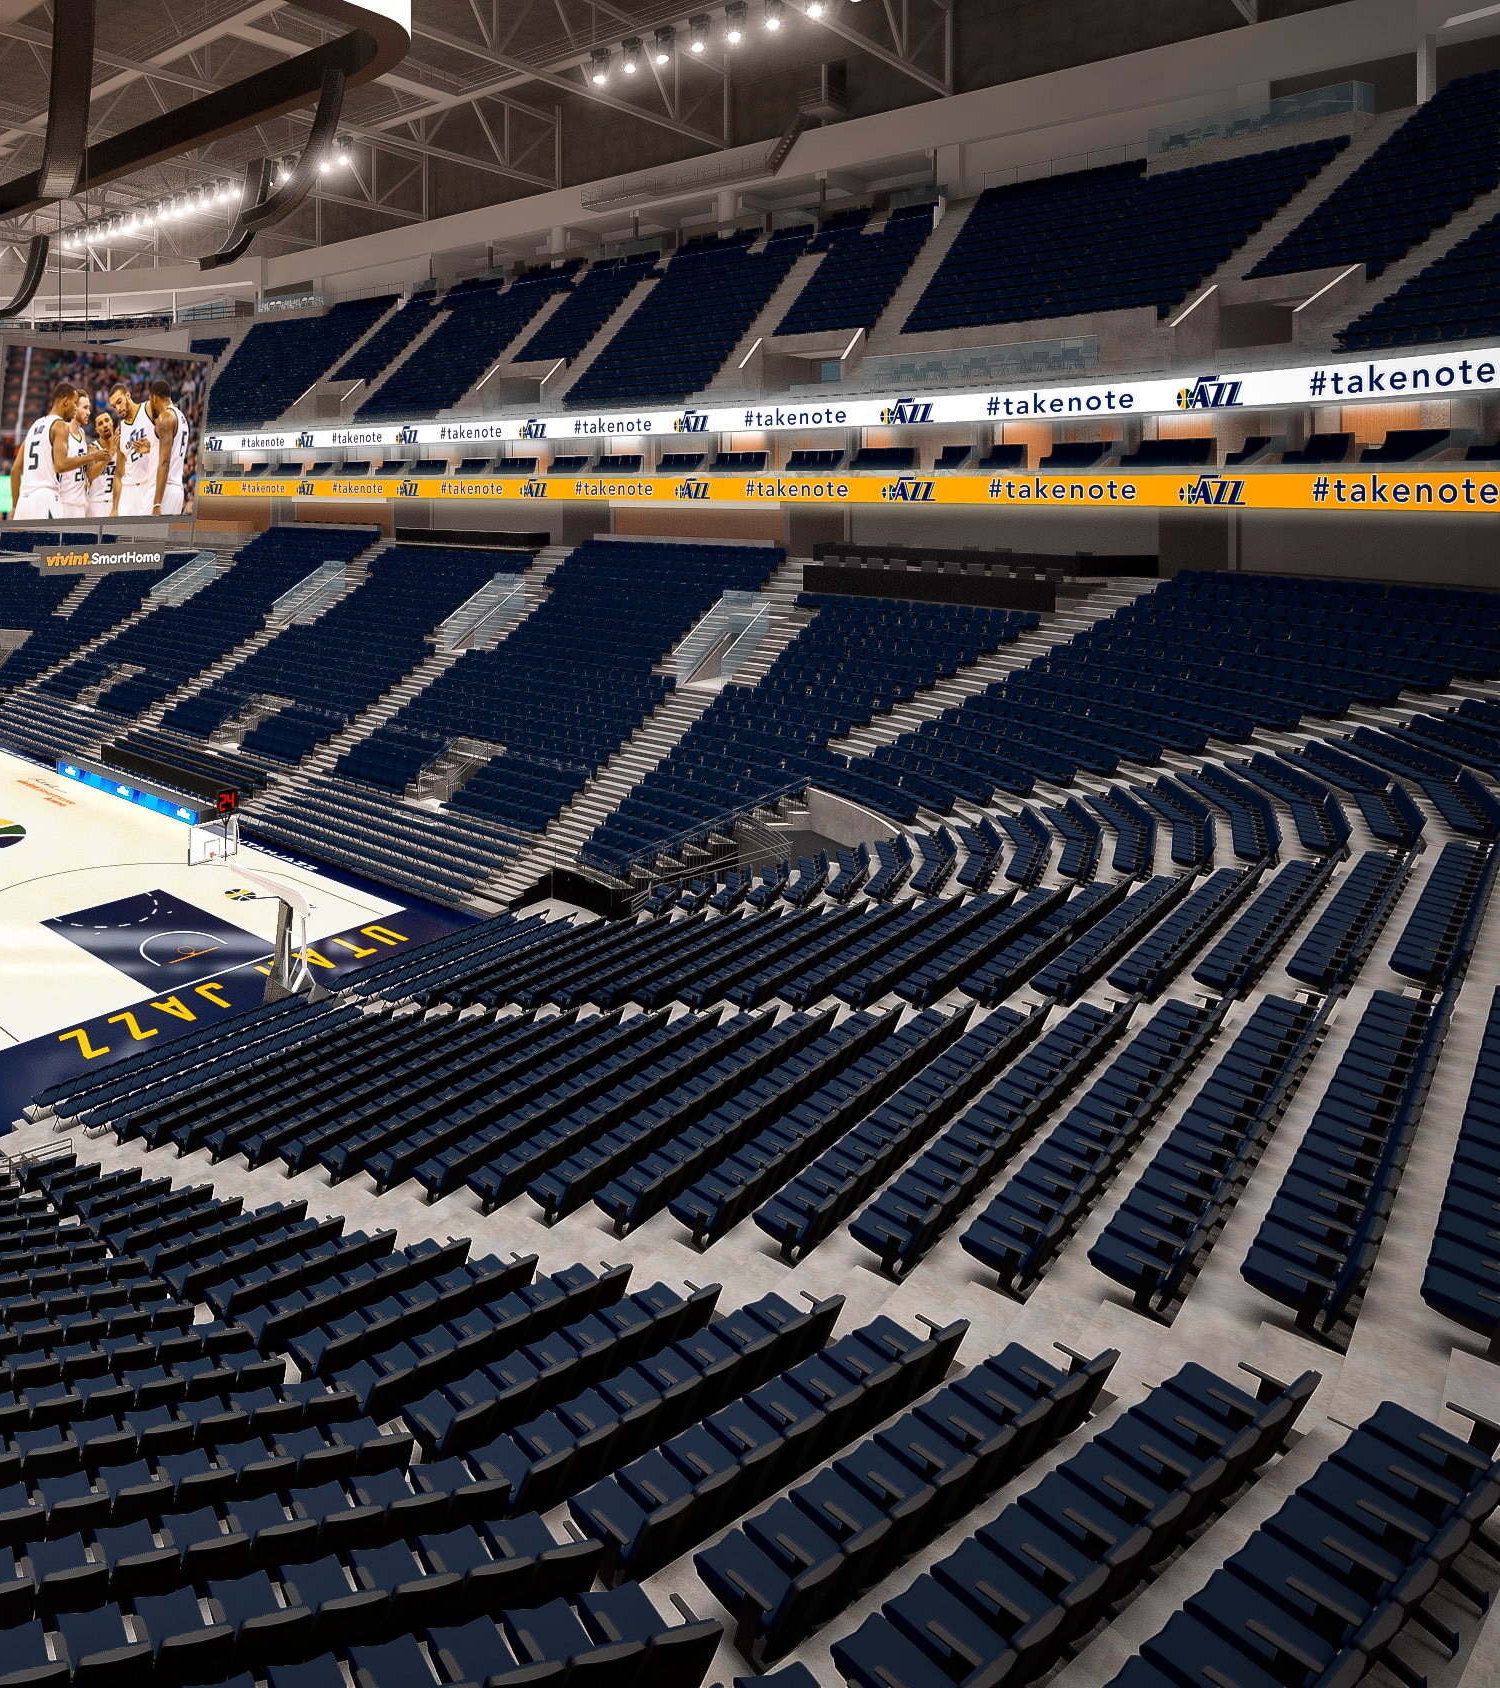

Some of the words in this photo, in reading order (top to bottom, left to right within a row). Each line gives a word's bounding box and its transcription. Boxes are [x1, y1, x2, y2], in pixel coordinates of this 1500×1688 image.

[242, 437, 284, 448] #takenote
[333, 432, 381, 445] #takenote
[441, 425, 501, 439] #takenote
[575, 418, 651, 435] #takenote
[745, 408, 847, 427] #takenote
[987, 390, 1133, 416] #takenote
[1310, 360, 1495, 396] #takenote
[28, 441, 40, 470] 5
[105, 478, 113, 493] 3
[241, 482, 285, 493] #takenote
[332, 481, 383, 494] #takenote
[441, 480, 503, 495] #takenote
[575, 479, 653, 496] #takenote
[745, 478, 849, 498] #takenote
[988, 477, 1137, 500] #takenote
[1312, 474, 1499, 504] #takenote
[218, 791, 235, 812] 24
[58, 982, 231, 1060] JAZZ
